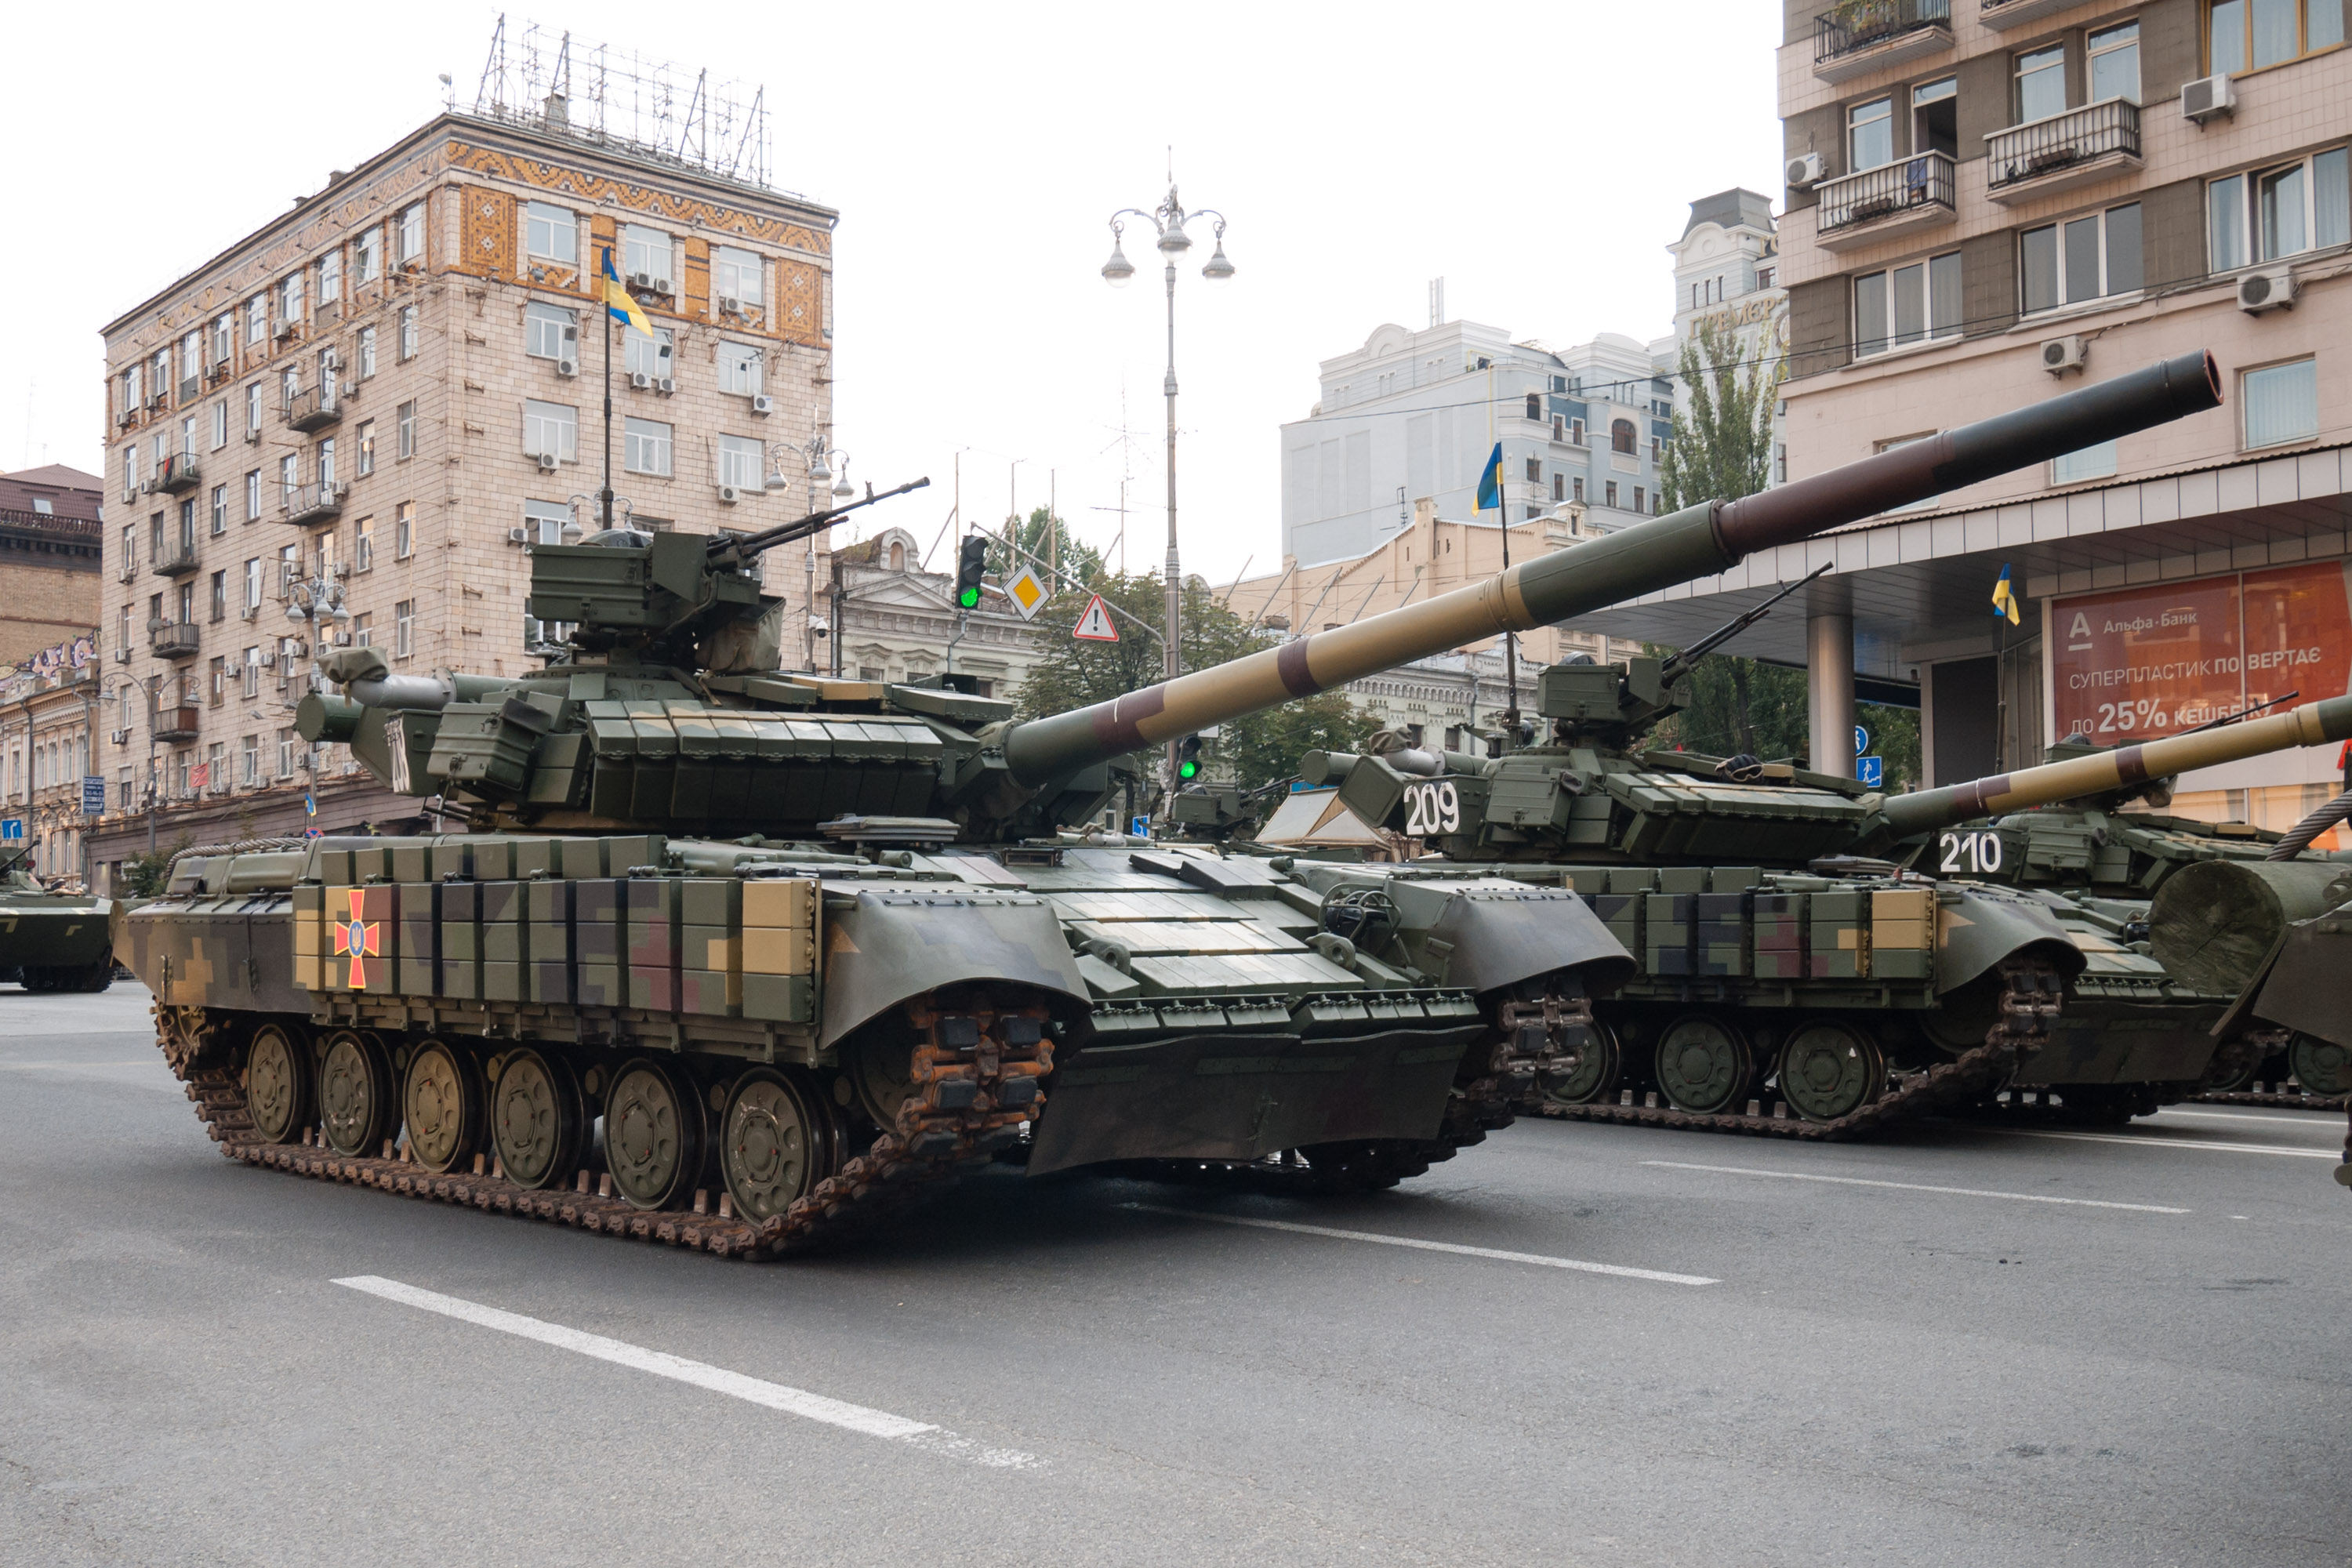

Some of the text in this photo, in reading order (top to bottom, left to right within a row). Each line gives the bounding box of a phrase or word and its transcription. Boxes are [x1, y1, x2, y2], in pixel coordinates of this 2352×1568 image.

[2070, 659, 2211, 690] СУПЕРПЛАСТИК
[2071, 718, 2093, 735] ДО
[2098, 698, 2167, 733] 25%
[1403, 781, 1460, 836] 209
[1940, 833, 2002, 873] 210
